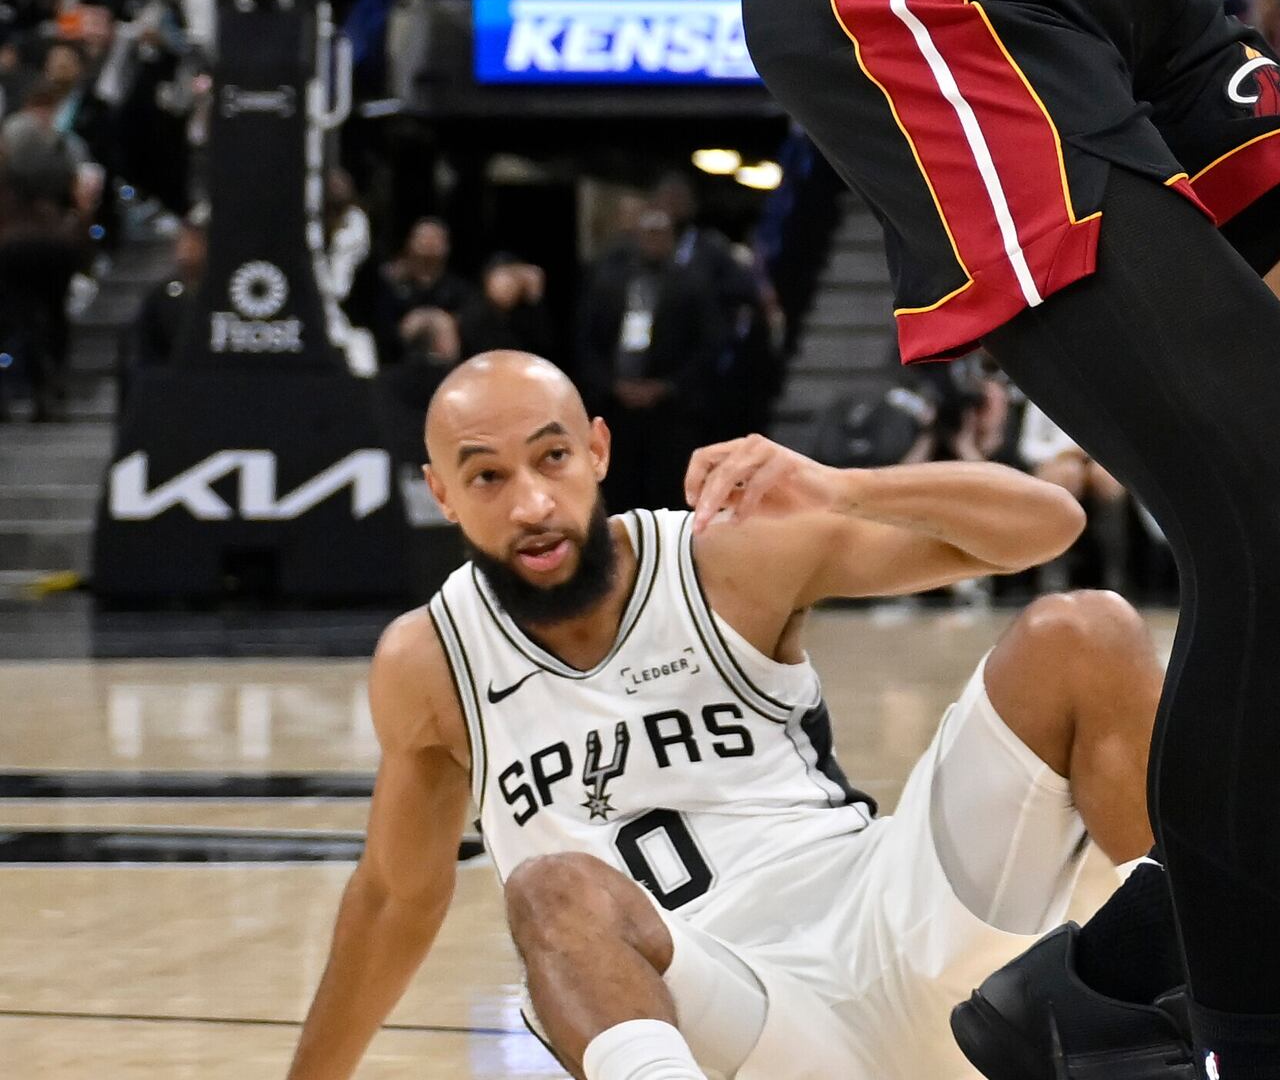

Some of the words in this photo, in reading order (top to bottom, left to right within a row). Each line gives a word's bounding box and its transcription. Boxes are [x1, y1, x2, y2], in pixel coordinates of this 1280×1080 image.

[109, 448, 392, 520] KIA
[630, 656, 691, 686] LEDGER
[498, 702, 755, 826] SPURS
[613, 806, 717, 912] 0
